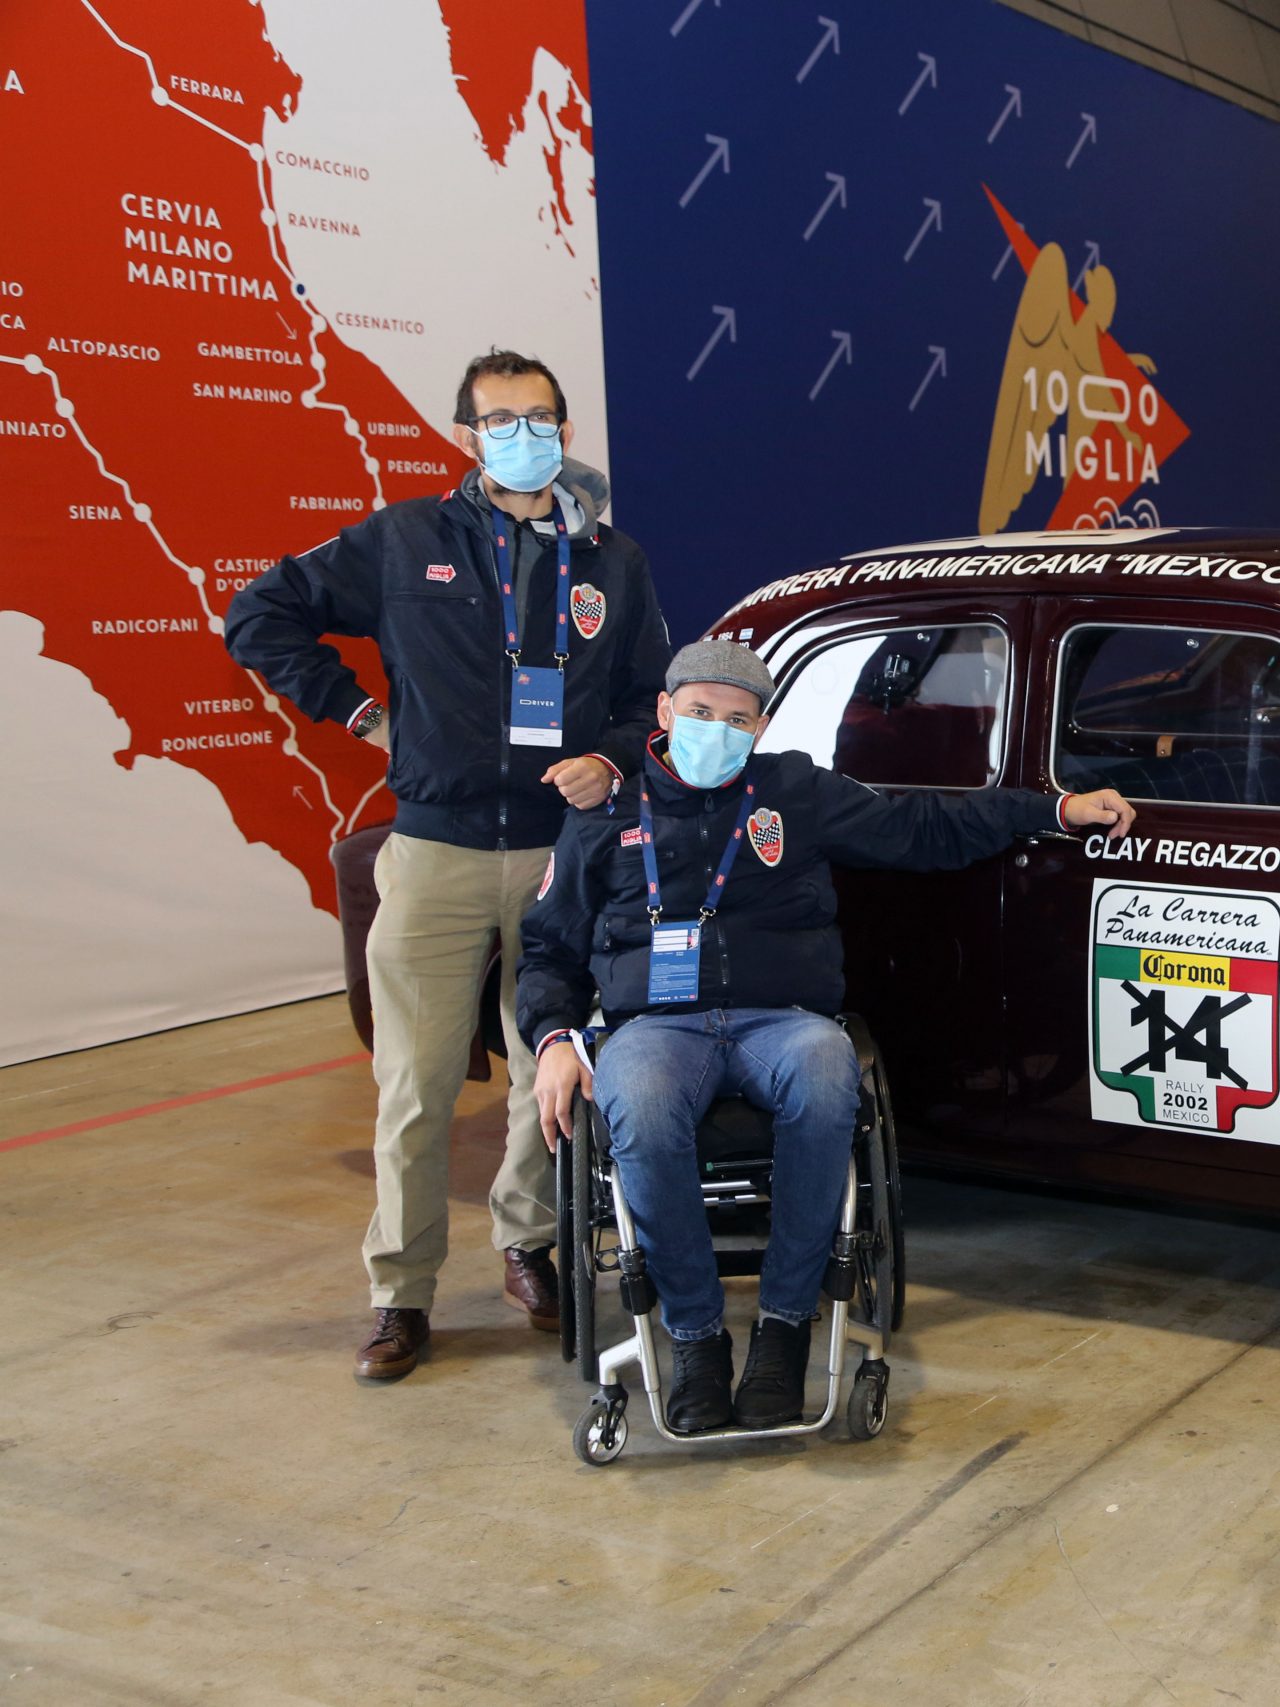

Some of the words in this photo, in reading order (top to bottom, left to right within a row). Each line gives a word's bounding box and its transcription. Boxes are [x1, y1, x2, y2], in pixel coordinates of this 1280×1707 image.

[171, 75, 245, 104] FERRARA
[275, 150, 370, 181] COMACCHIO
[121, 193, 222, 230] CERVIA
[288, 212, 361, 237] RAVENNA
[124, 227, 233, 264] MILANO
[127, 261, 279, 302] MARITTIMA
[335, 312, 424, 335] CESENATICO
[47, 337, 161, 362] ALTOPASCIO
[197, 342, 303, 366] GAMBETTOLA
[192, 383, 225, 399] SAN
[229, 387, 292, 404] MARINO
[1023, 366, 1159, 427] 1000
[0, 420, 67, 438] INIATO
[368, 422, 421, 438] URBINO
[387, 460, 448, 475] PERGOLA
[1024, 430, 1160, 484] MIGLIA
[69, 505, 122, 521] SIENA
[290, 496, 364, 511] FABRIANO
[848, 553, 1112, 584] PANAMERICANA
[92, 619, 199, 635] RADICOFANI
[185, 699, 254, 715] VITERBO
[519, 698, 555, 707] DRIVER
[162, 731, 273, 752] RONCIGLIONE
[1084, 834, 1151, 862] CLAY
[1116, 894, 1153, 918] La
[1162, 897, 1261, 927] Carrera
[1105, 917, 1269, 954] Panamericana
[1143, 953, 1226, 985] Corona
[1165, 1079, 1205, 1093] RALLY
[1163, 1092, 1208, 1111] 2002
[1162, 1108, 1210, 1124] MEXICO
